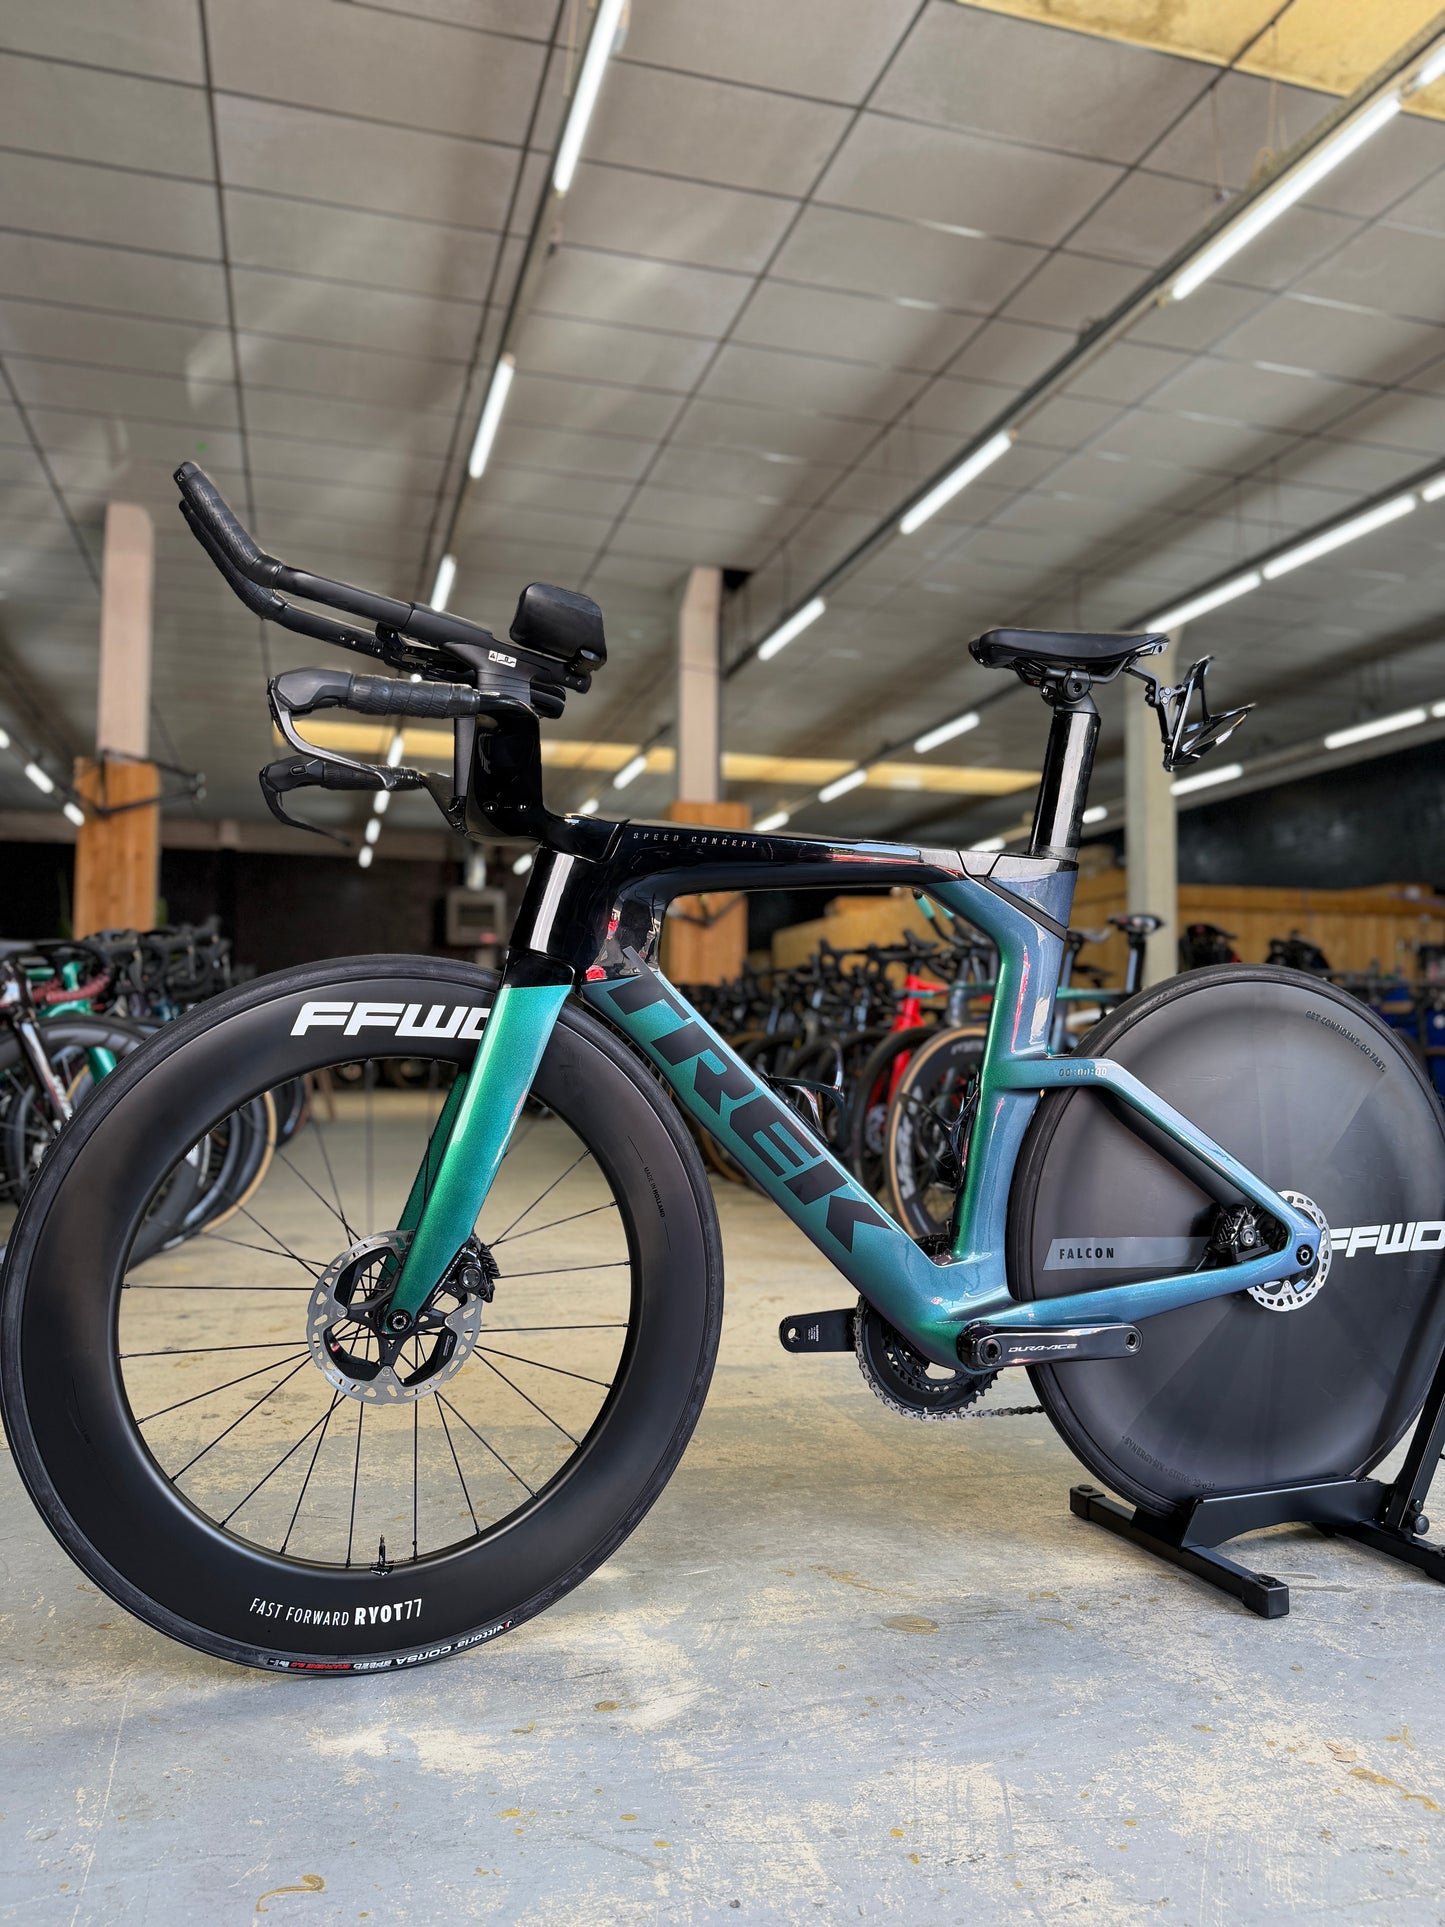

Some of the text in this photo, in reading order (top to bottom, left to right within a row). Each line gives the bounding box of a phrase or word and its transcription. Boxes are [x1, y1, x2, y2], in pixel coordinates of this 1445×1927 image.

[633, 832, 757, 849] SPEED CONCEPT
[1305, 1010, 1320, 1022] GET
[1360, 1043, 1371, 1055] GO
[606, 945, 902, 1254] TREK
[653, 1189, 666, 1218] HOLLAND
[1059, 1247, 1114, 1260] FALCON
[1008, 1343, 1078, 1353] DURA-ACE
[249, 1597, 423, 1627] FAST FORWARD RYOT77
[395, 1644, 452, 1665] CORSA
